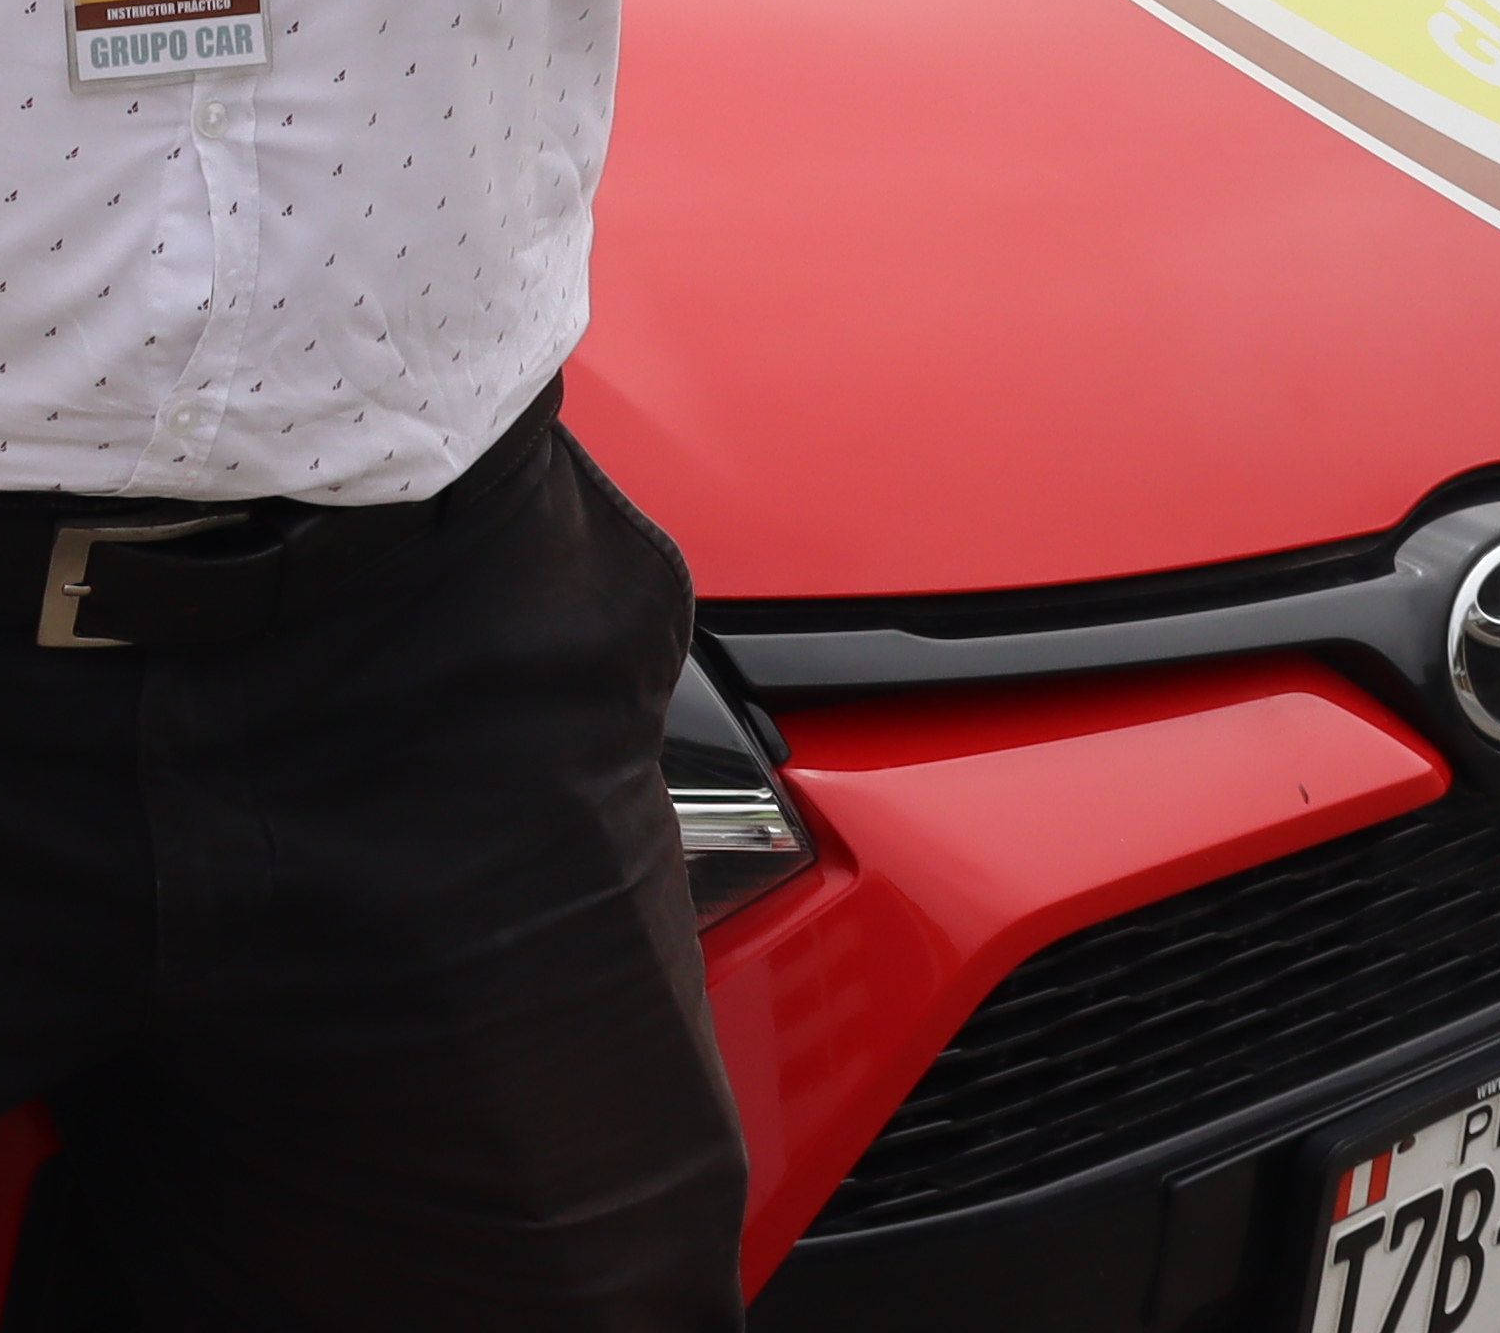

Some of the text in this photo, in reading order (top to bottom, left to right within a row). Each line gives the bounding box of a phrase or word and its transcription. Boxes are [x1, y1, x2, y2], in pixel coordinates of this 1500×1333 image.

[107, 2, 175, 21] INSTRUCTOR
[90, 23, 253, 69] GRUPO CAR
